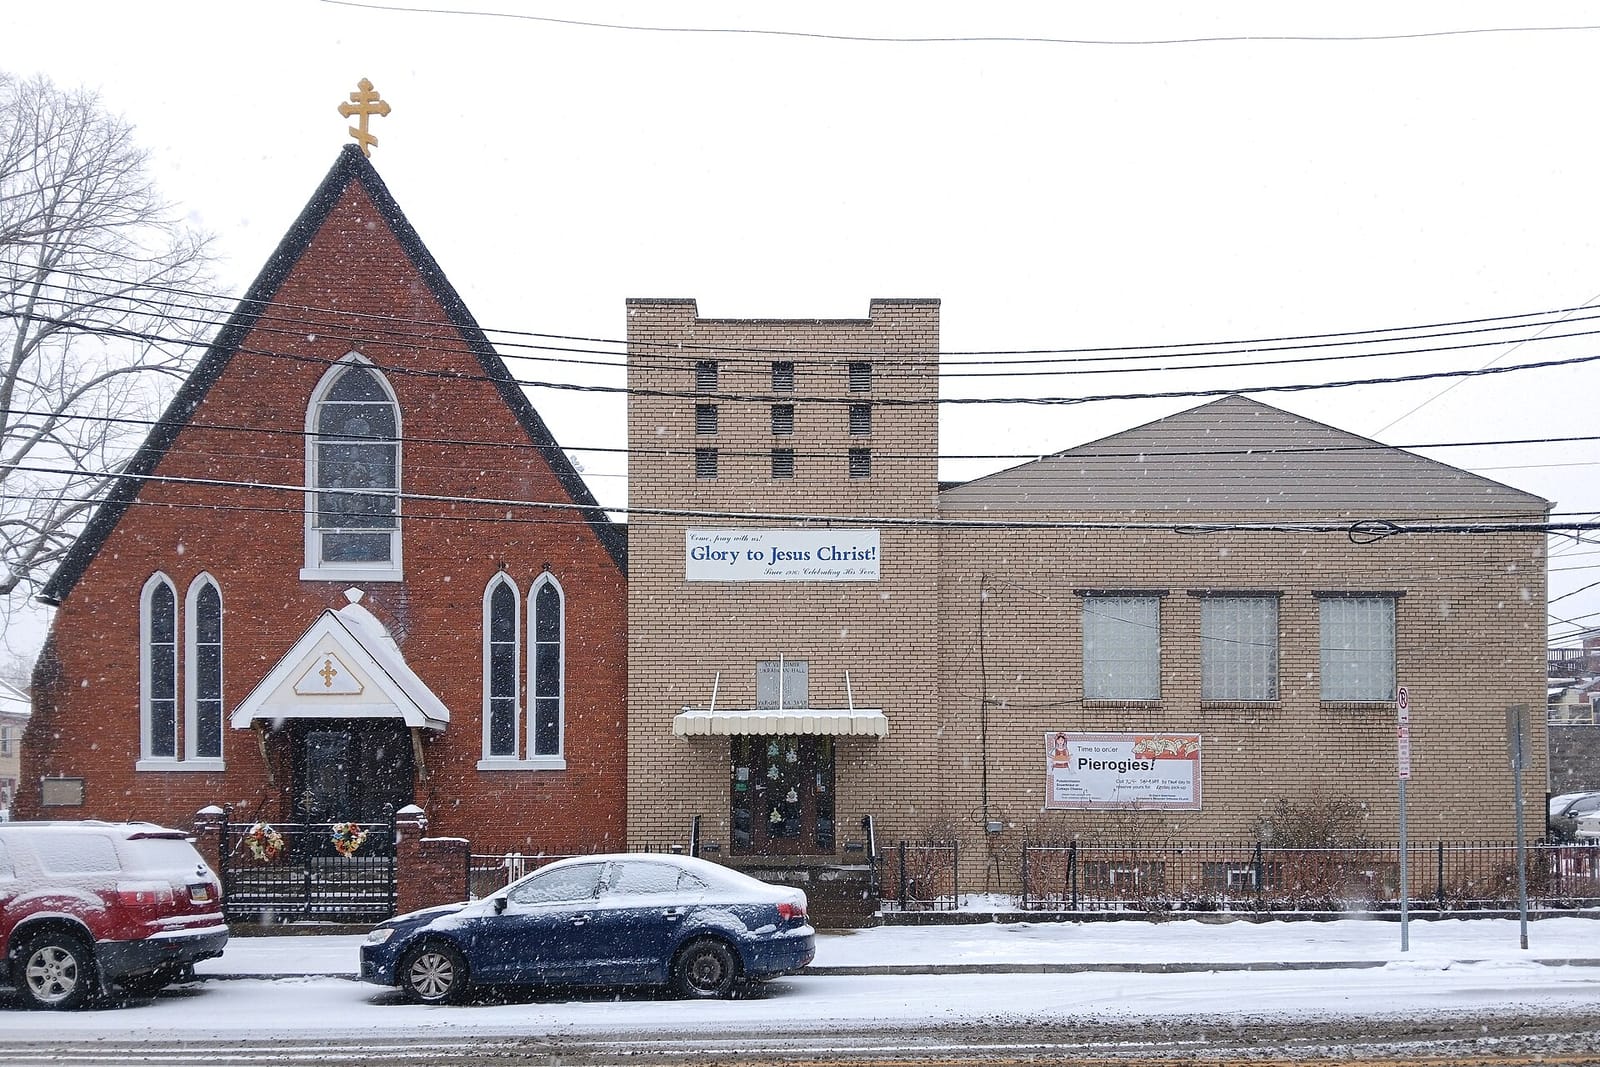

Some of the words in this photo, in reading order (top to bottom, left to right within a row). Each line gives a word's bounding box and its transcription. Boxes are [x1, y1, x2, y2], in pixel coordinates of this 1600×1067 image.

[713, 534, 732, 543] pray
[733, 534, 749, 542] with
[751, 534, 763, 542] us!
[690, 545, 740, 565] Glory
[747, 549, 764, 561] to
[768, 546, 811, 565] Jesus
[817, 545, 876, 561] Christ!
[763, 567, 783, 576] Since
[802, 567, 841, 577] Celebrating
[1077, 745, 1093, 753] Time
[1078, 758, 1156, 773] Pierogies!
